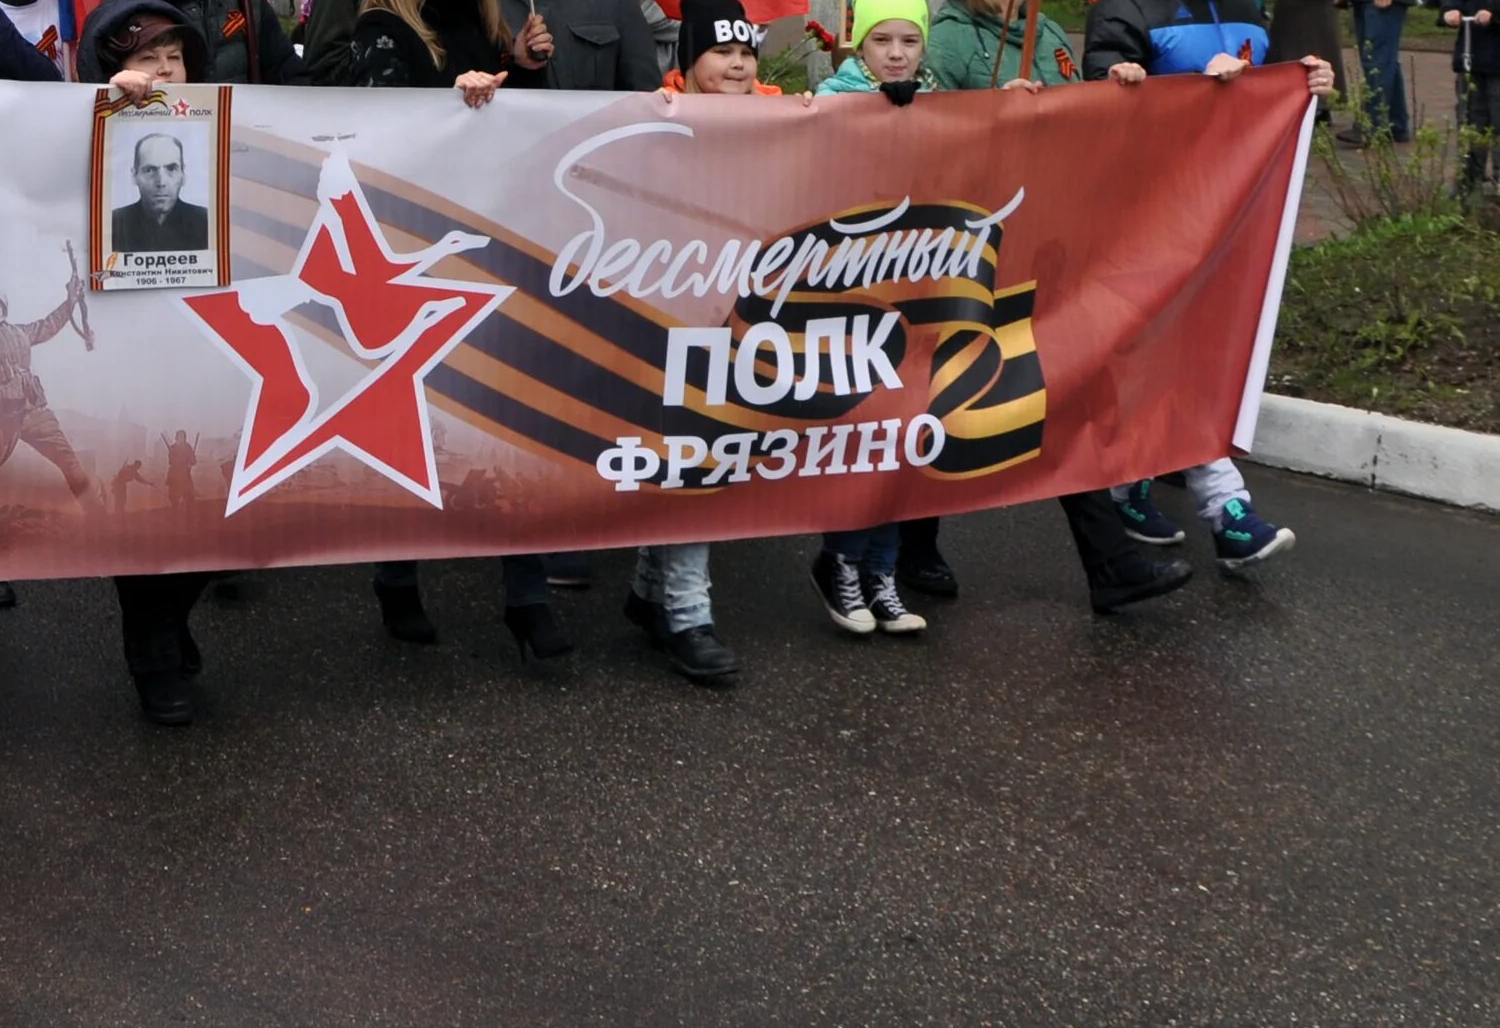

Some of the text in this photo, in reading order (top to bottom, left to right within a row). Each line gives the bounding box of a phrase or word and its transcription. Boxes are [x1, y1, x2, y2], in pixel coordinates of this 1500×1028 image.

[714, 19, 759, 48] BOY
[123, 253, 198, 269] Гордеев
[164, 268, 213, 276] Никитович
[136, 277, 157, 285] 1906
[165, 276, 186, 284] 1967
[662, 312, 904, 406] ПОЛК
[596, 413, 946, 491] ФРЯЗИНО
